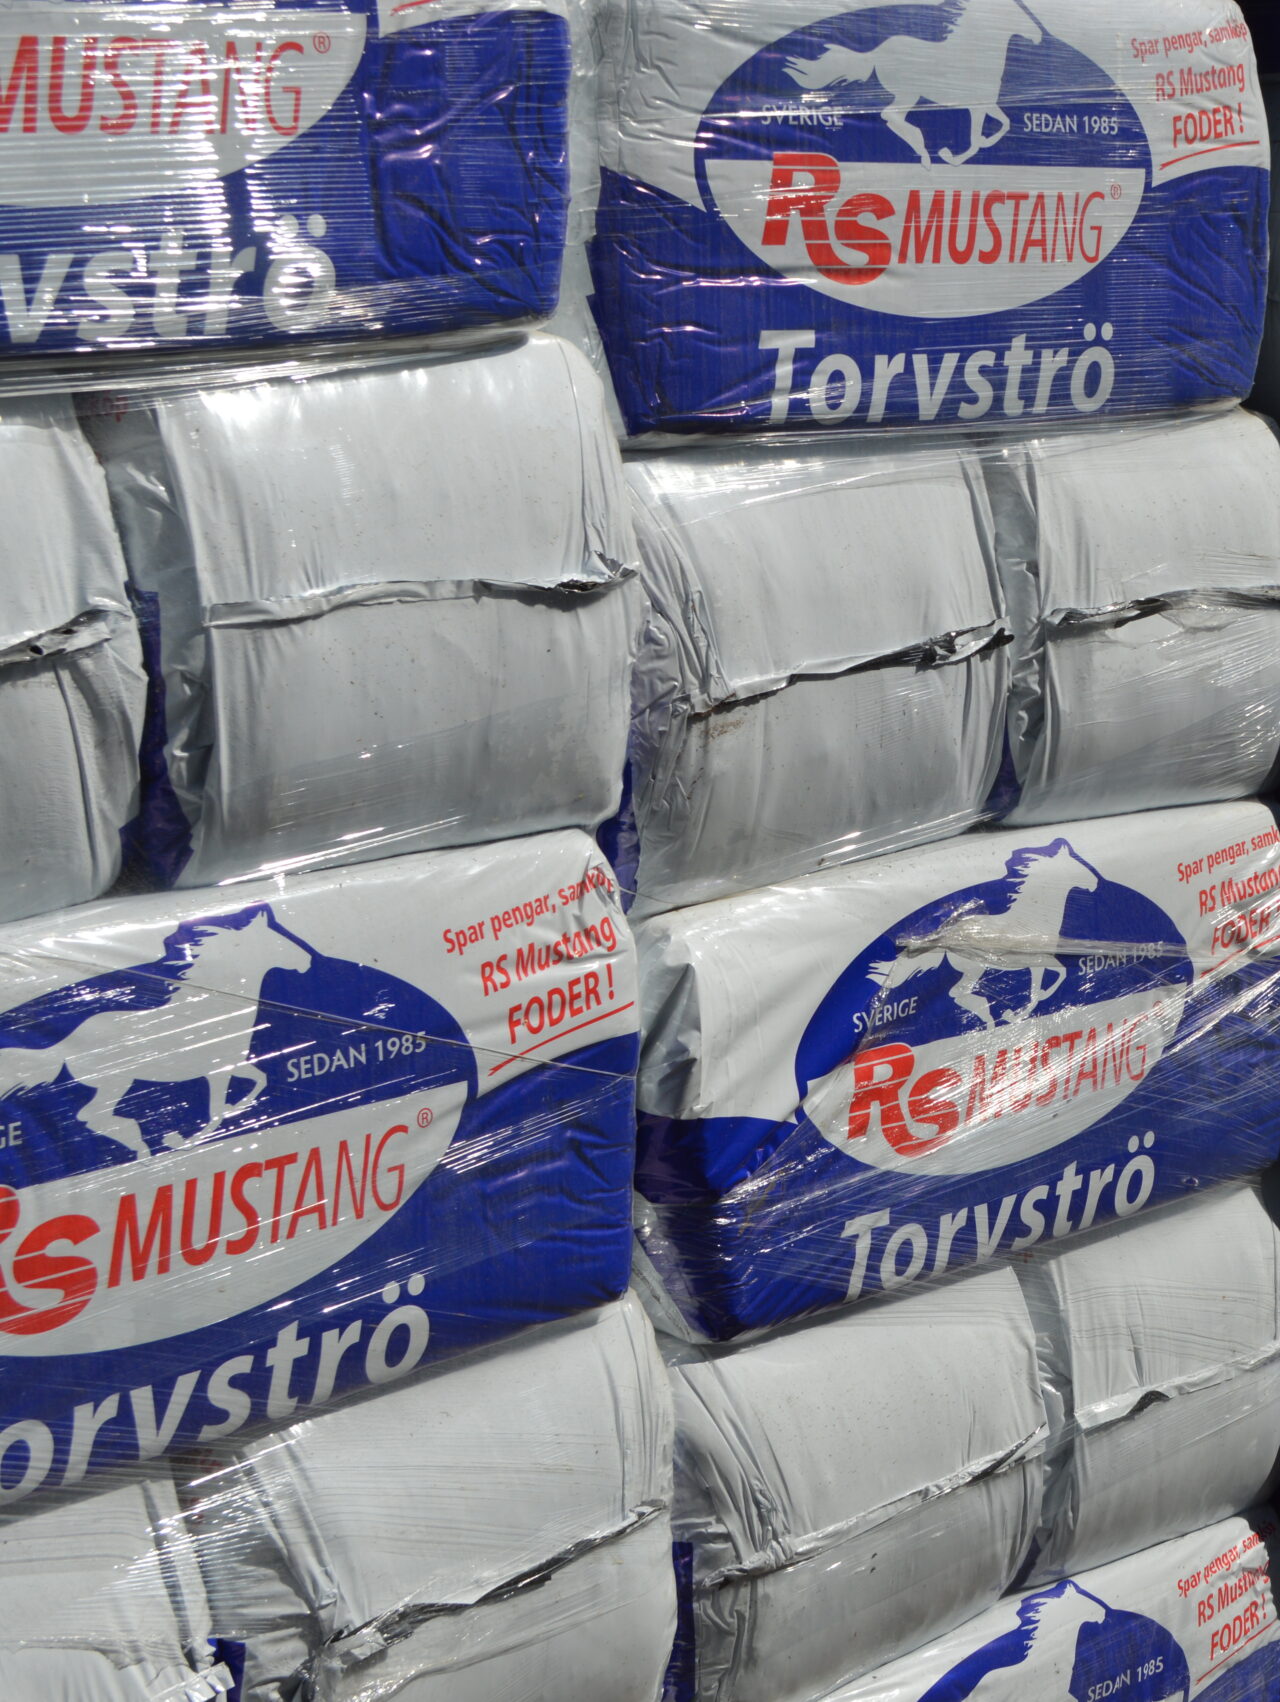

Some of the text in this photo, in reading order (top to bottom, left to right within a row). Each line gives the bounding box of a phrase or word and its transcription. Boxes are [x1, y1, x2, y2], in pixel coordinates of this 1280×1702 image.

[1131, 38, 1160, 63] Spar
[1163, 31, 1207, 58] pengar,
[1155, 64, 1245, 101] RS Mustang
[762, 102, 844, 128] SVERIGE
[1024, 112, 1119, 136] SEDAN 1985
[761, 152, 1105, 285] RS MUSTANG
[0, 214, 336, 343] vströ
[758, 322, 1116, 427] Torvströ
[1177, 858, 1204, 884] Spar
[1206, 840, 1250, 875] pengar,
[443, 921, 485, 955] Spar
[490, 894, 556, 941] pengar,
[1199, 884, 1217, 917] RS
[480, 916, 617, 997] RS Mustang
[1078, 940, 1164, 976] SEDAN 1985
[852, 996, 919, 1033] SVERIGE
[287, 1031, 427, 1082] SEDAN 1985
[847, 1013, 1148, 1158] RS MUSTANG
[107, 1124, 408, 1288] MUSTANG
[840, 1130, 1157, 1304] Torvströ
[0, 1273, 430, 1501] orvströ
[1177, 1569, 1201, 1598] Spar
[1203, 1545, 1241, 1584] pengar,
[1197, 1560, 1271, 1628] RS Mustang
[1087, 1657, 1164, 1702] SEDAN 1985
